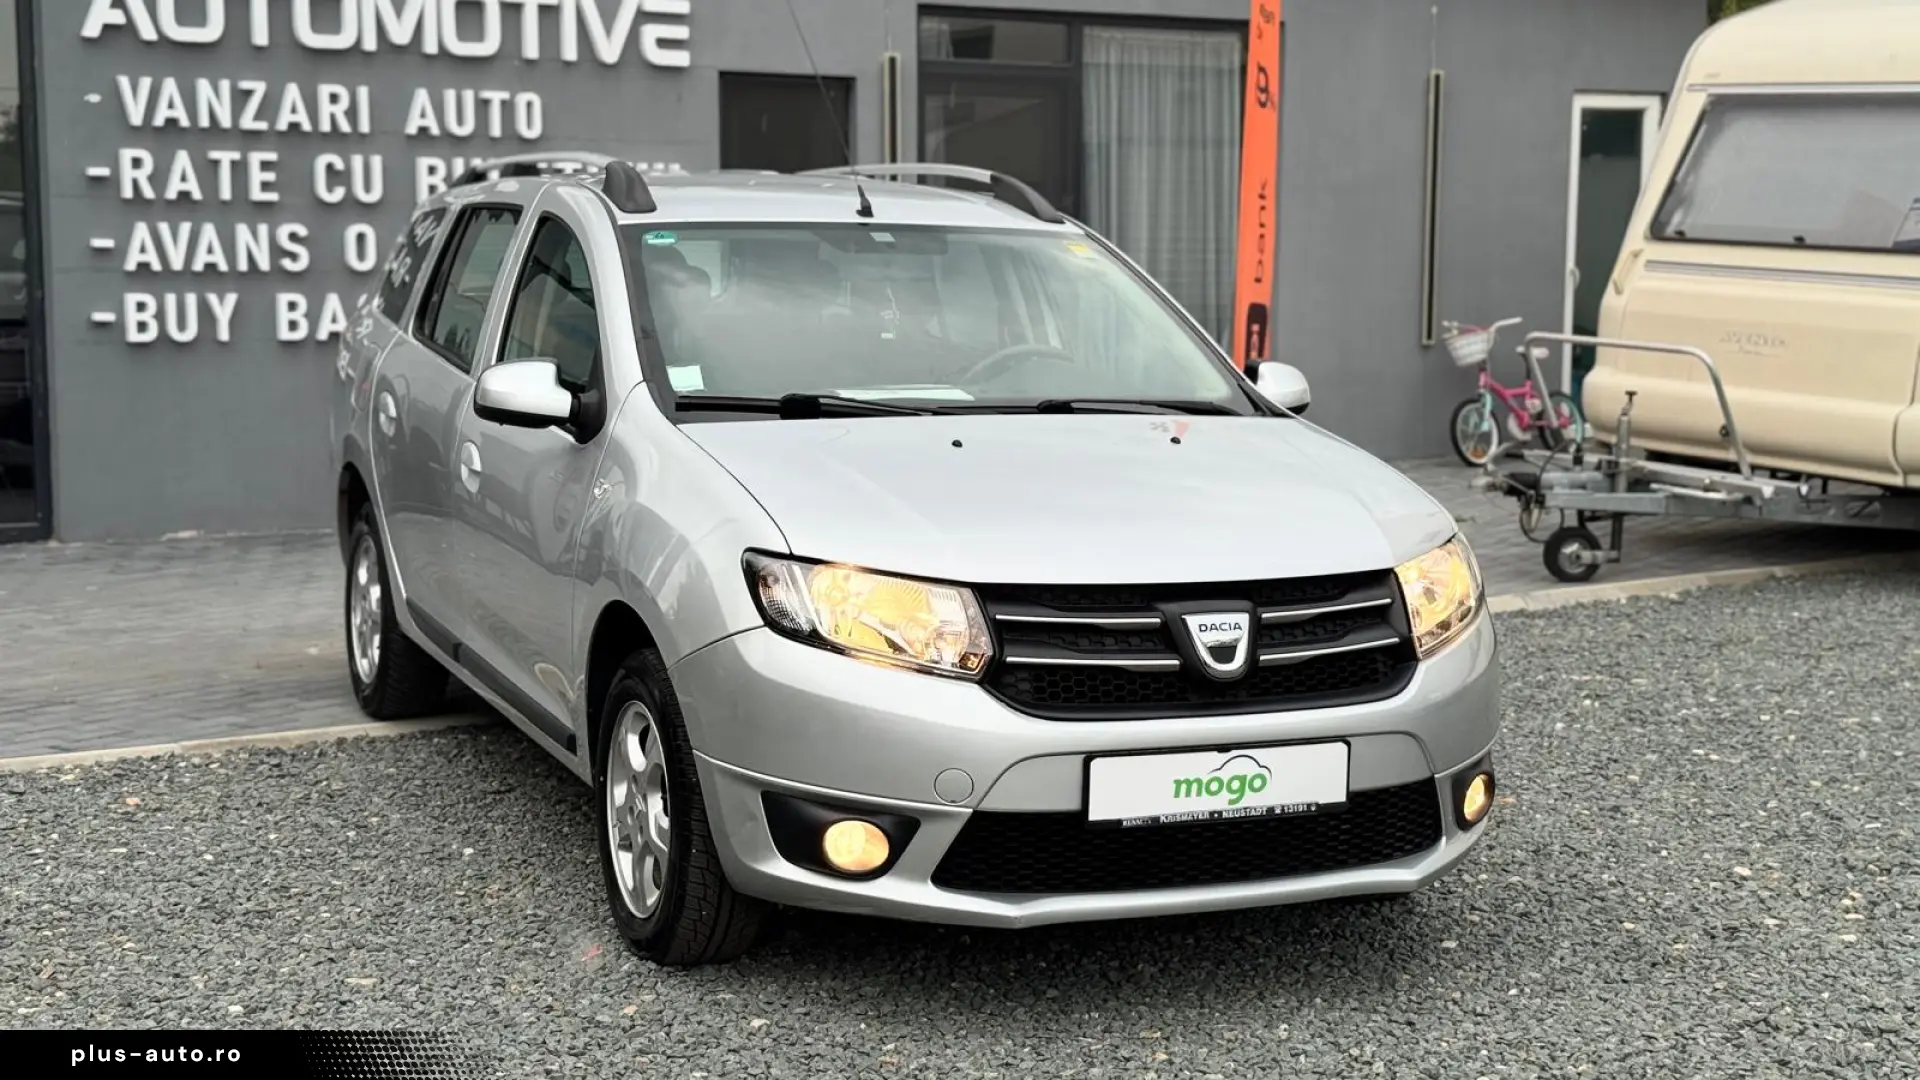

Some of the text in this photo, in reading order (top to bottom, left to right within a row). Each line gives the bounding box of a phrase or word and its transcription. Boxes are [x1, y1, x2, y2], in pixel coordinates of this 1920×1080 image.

[80, 0, 691, 67] AUTOMOTIVE
[405, 88, 543, 139] AUTO
[314, 153, 383, 203] CU
[277, 293, 347, 341] BA
[1198, 622, 1243, 633] DACIA
[1173, 772, 1267, 805] mogo
